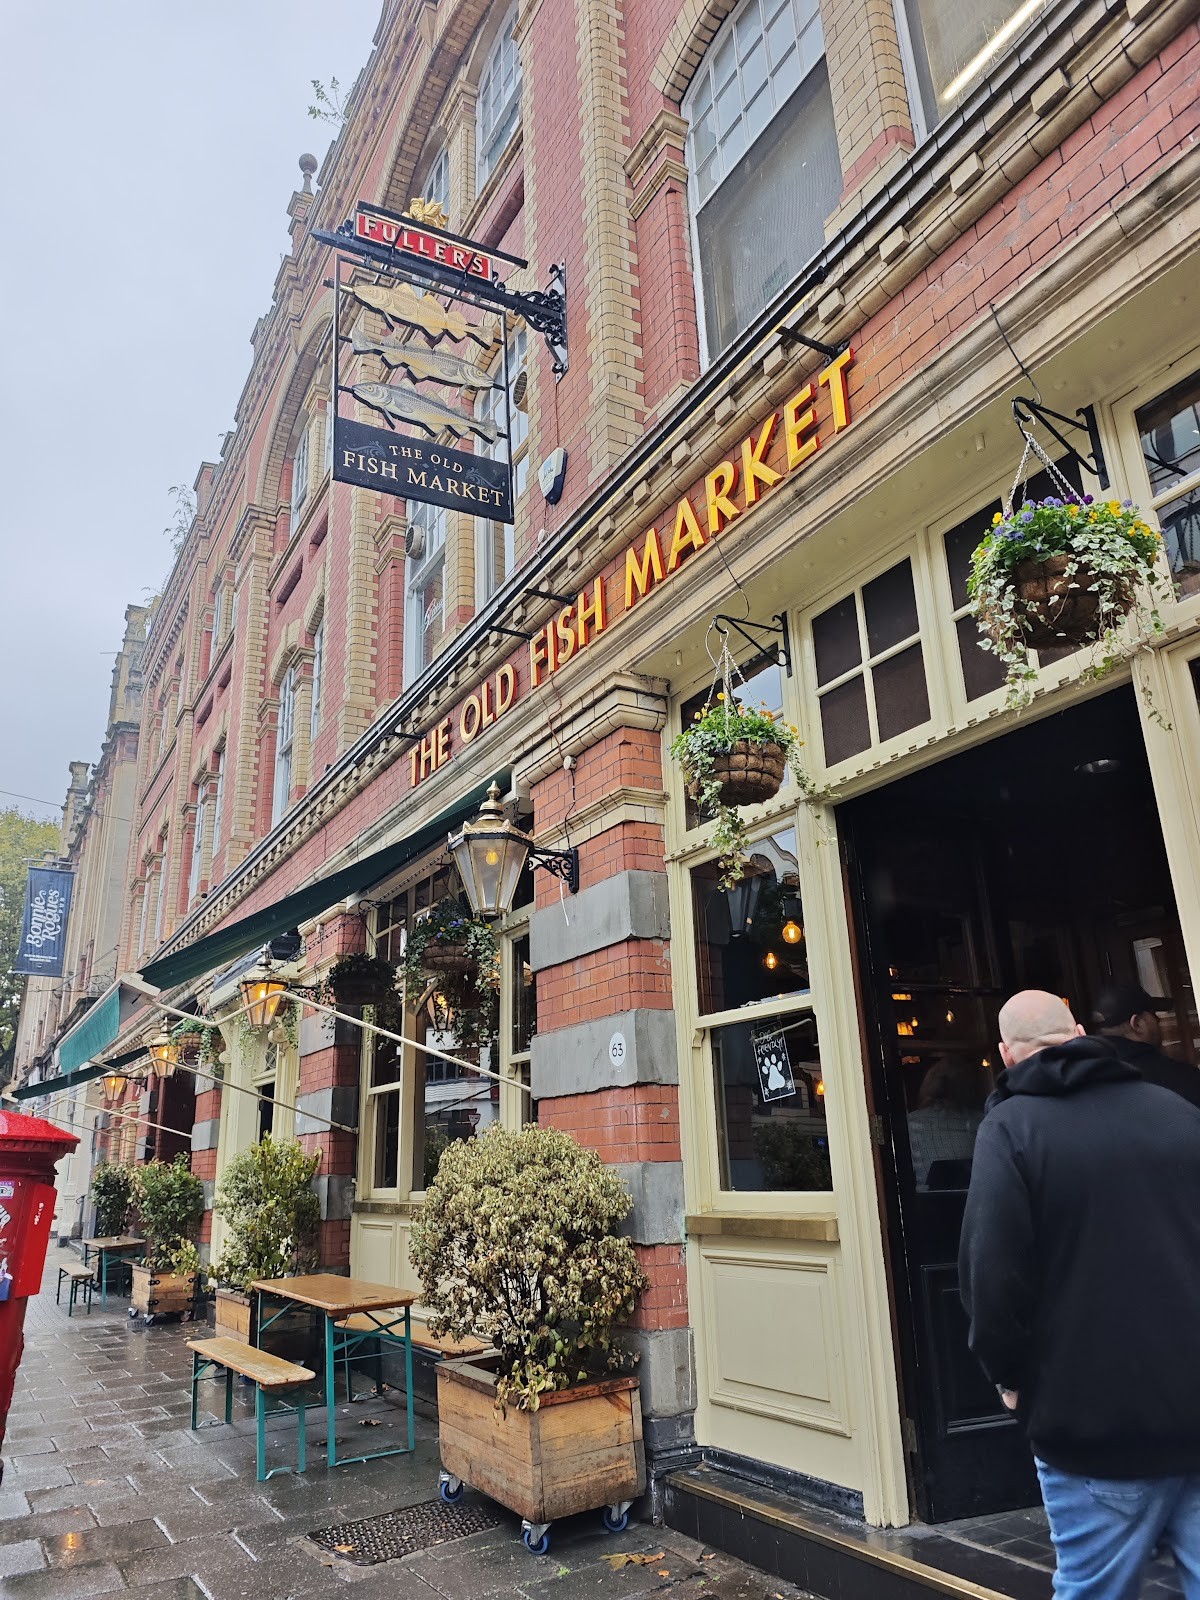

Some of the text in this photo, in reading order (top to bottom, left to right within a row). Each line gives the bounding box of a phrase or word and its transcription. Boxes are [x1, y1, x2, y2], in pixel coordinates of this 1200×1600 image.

[343, 450, 398, 480] FISH
[407, 467, 504, 507] MARKET
[388, 445, 463, 473] THE OLD
[409, 347, 855, 788] THE OLD FISH MARKET
[26, 889, 47, 948] Bonnie
[42, 889, 61, 941] Rogues
[611, 1043, 624, 1057] 63
